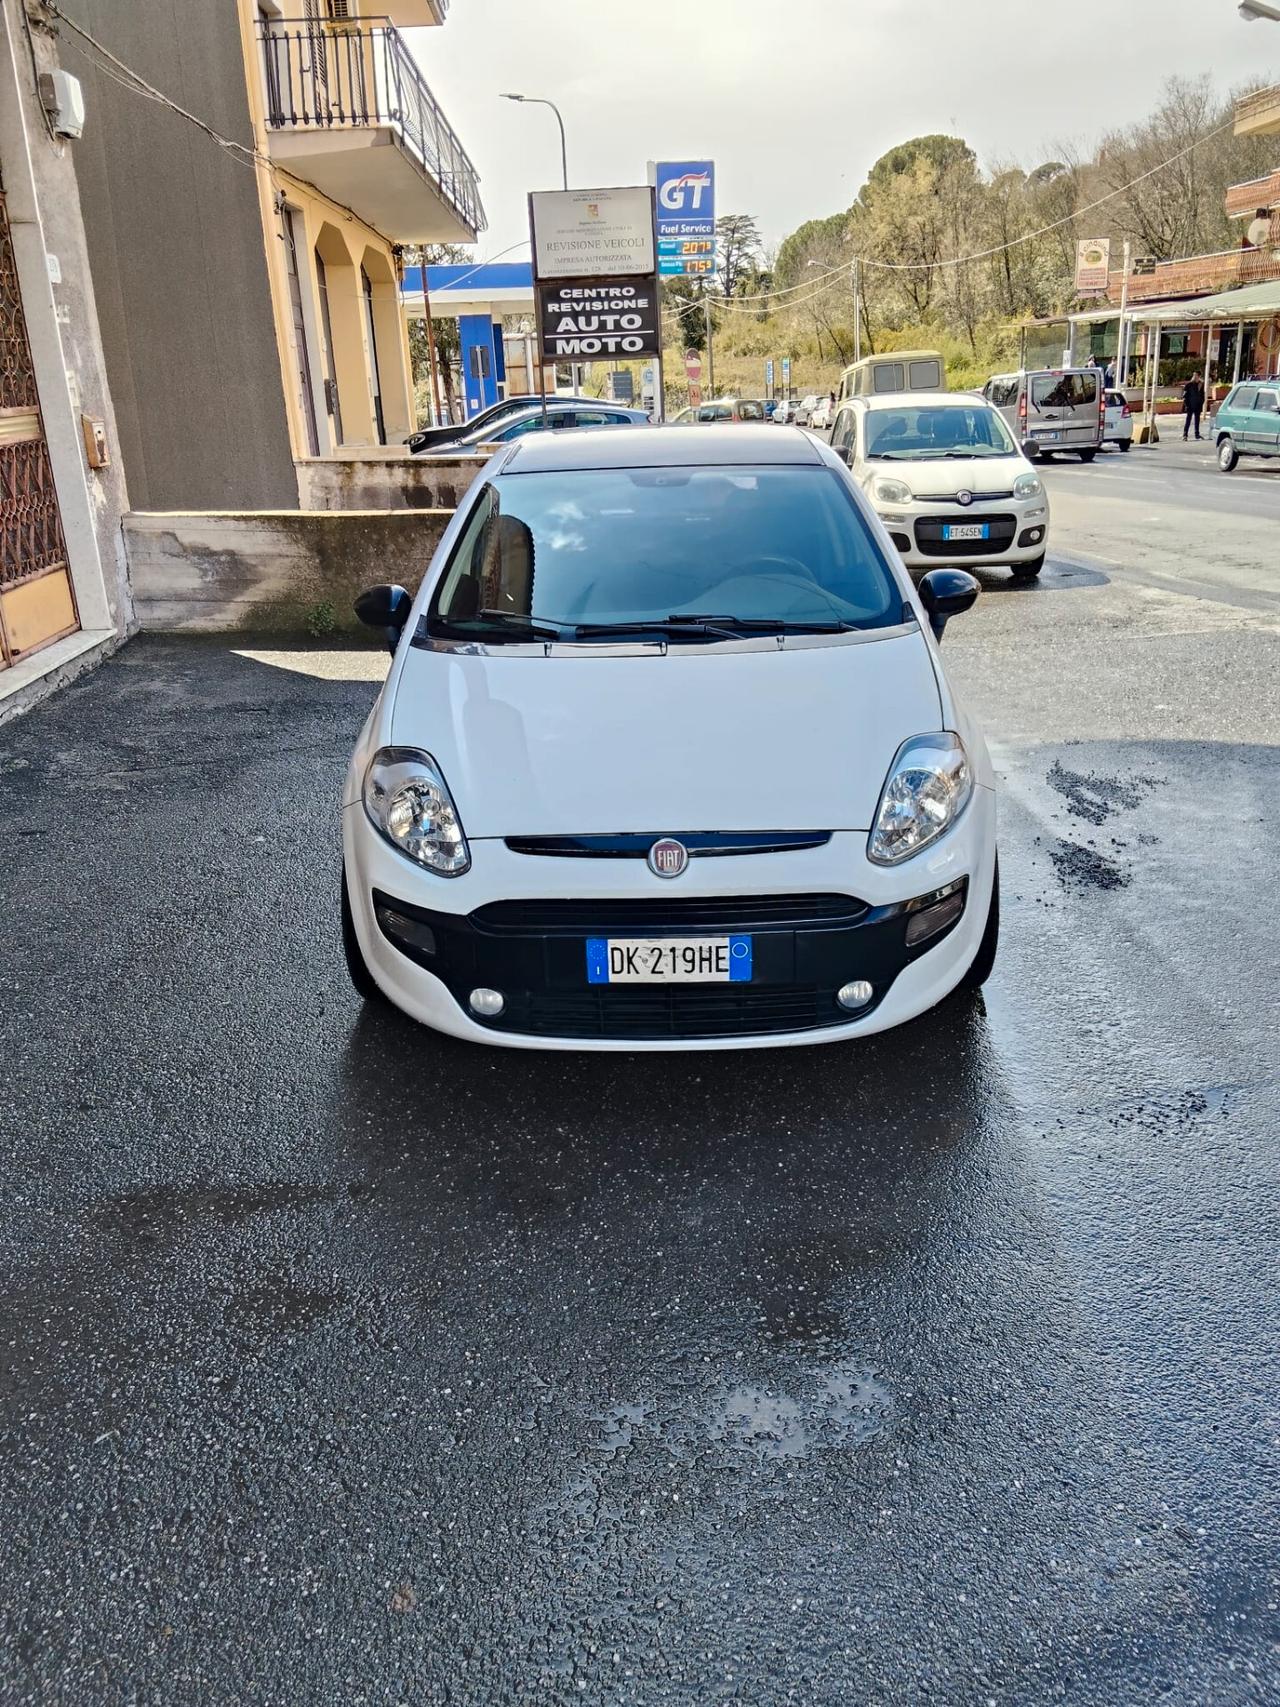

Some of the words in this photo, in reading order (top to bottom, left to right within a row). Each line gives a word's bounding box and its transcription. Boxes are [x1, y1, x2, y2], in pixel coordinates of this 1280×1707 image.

[660, 176, 711, 210] GT
[660, 224, 679, 234] Fuel
[680, 223, 712, 233] Service
[546, 240, 601, 252] REVISIONE
[603, 238, 645, 248] VEICOLI
[554, 256, 583, 265] IMPRESA
[584, 255, 632, 263] AUTORIZZATA
[559, 287, 636, 299] CENTRO
[547, 298, 649, 312] REVISIONE
[556, 313, 643, 333] AUTO
[556, 336, 644, 355] MOTO
[657, 850, 680, 867] FIAT
[611, 946, 640, 975] DK
[650, 945, 730, 975] 219HE
